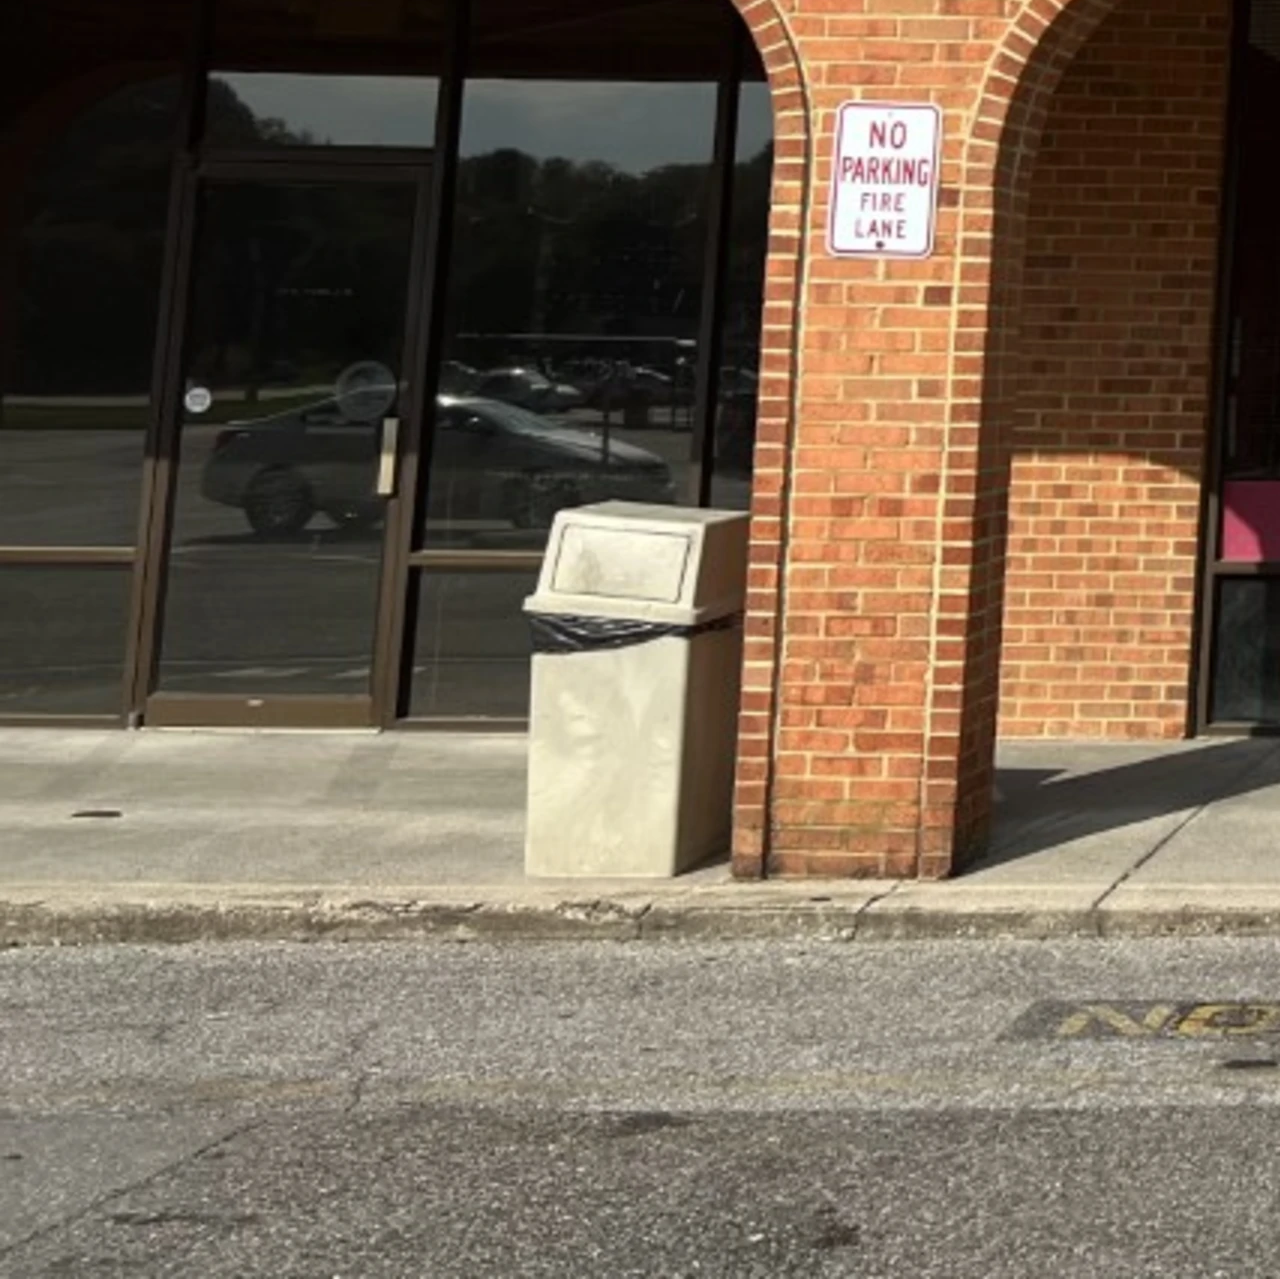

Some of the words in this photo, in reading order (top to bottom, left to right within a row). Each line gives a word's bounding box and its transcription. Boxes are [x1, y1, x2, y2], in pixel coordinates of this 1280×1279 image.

[869, 121, 907, 149] NO
[841, 157, 929, 186] PARKING
[860, 193, 905, 212] FIRE
[855, 219, 906, 239] LANE
